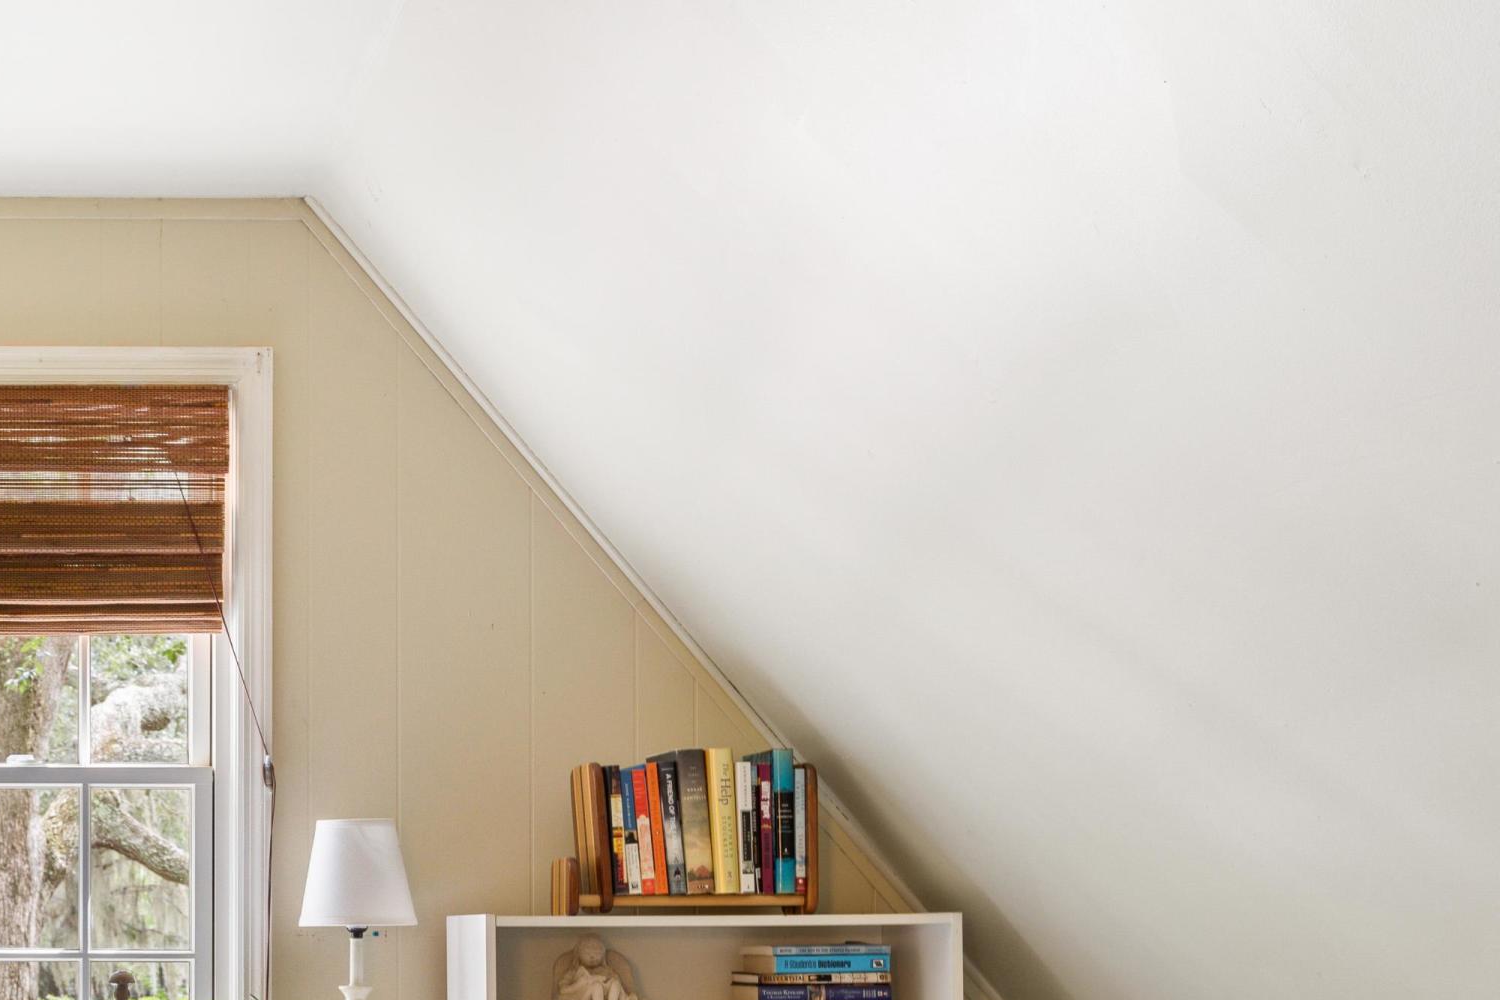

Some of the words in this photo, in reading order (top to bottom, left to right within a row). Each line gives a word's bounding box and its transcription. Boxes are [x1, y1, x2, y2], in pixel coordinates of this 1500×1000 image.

[666, 780, 674, 804] FRIEND
[718, 778, 731, 805] Help
[668, 805, 675, 815] OF
[818, 960, 851, 969] Dictionary
